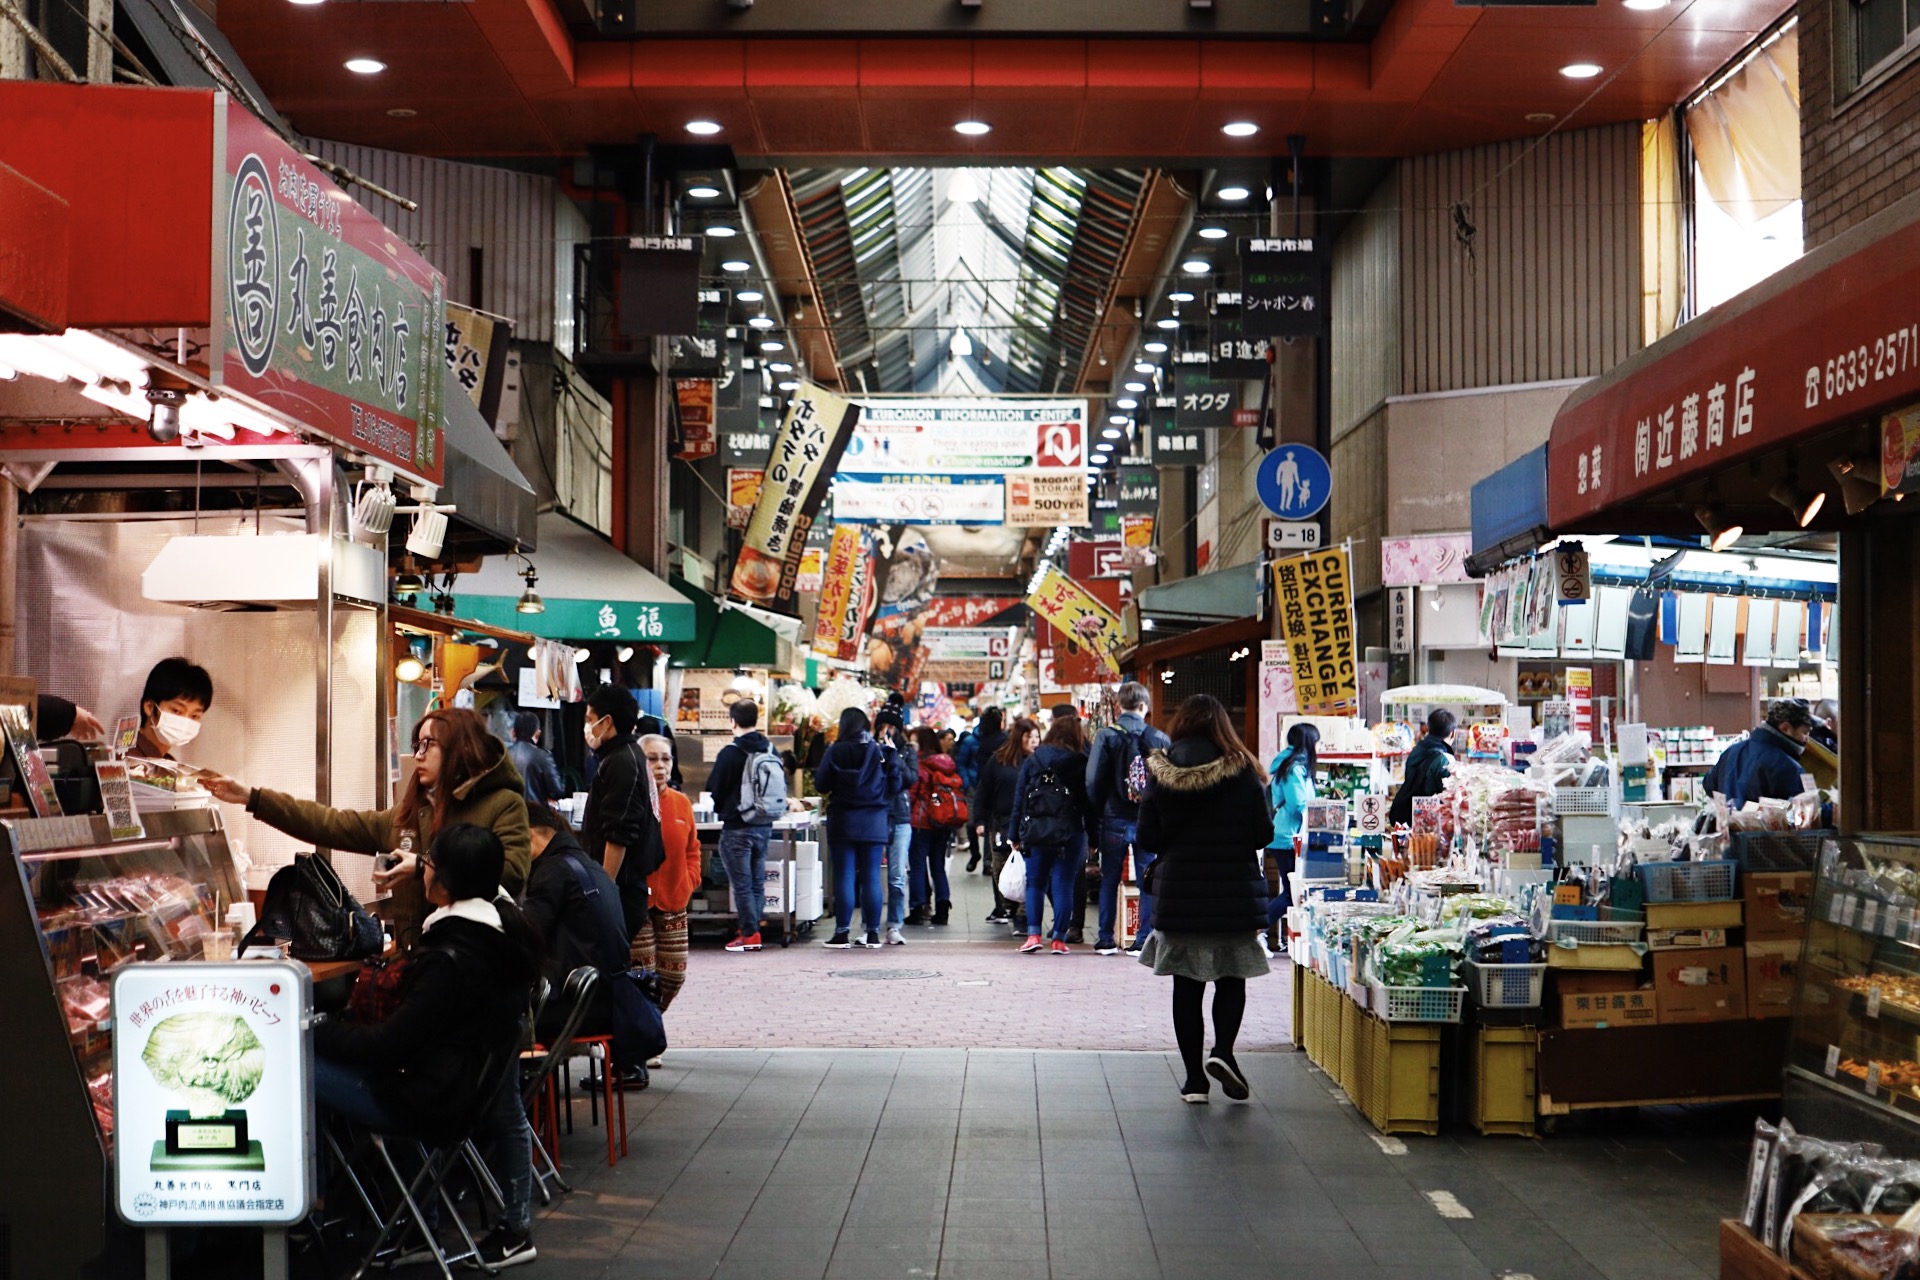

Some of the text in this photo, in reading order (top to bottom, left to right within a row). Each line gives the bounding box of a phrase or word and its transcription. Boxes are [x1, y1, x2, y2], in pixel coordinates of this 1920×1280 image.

[287, 227, 409, 411] 丸善食肉店
[1247, 295, 1316, 312] シャボン春
[872, 408, 935, 421] KUROMON
[941, 408, 1025, 421] INFORMATION
[1183, 392, 1231, 411] オクダ
[985, 456, 1025, 468] machine
[1034, 499, 1083, 510] 500YEN
[1278, 565, 1307, 639] 货币兑换
[595, 604, 663, 637] 魚福
[1301, 559, 1338, 698] EXCHANGE
[1322, 556, 1356, 692] CURRENCY
[1293, 643, 1314, 681] 환전
[128, 984, 281, 1028] 世界の舌を魅了する神戸ビーフ
